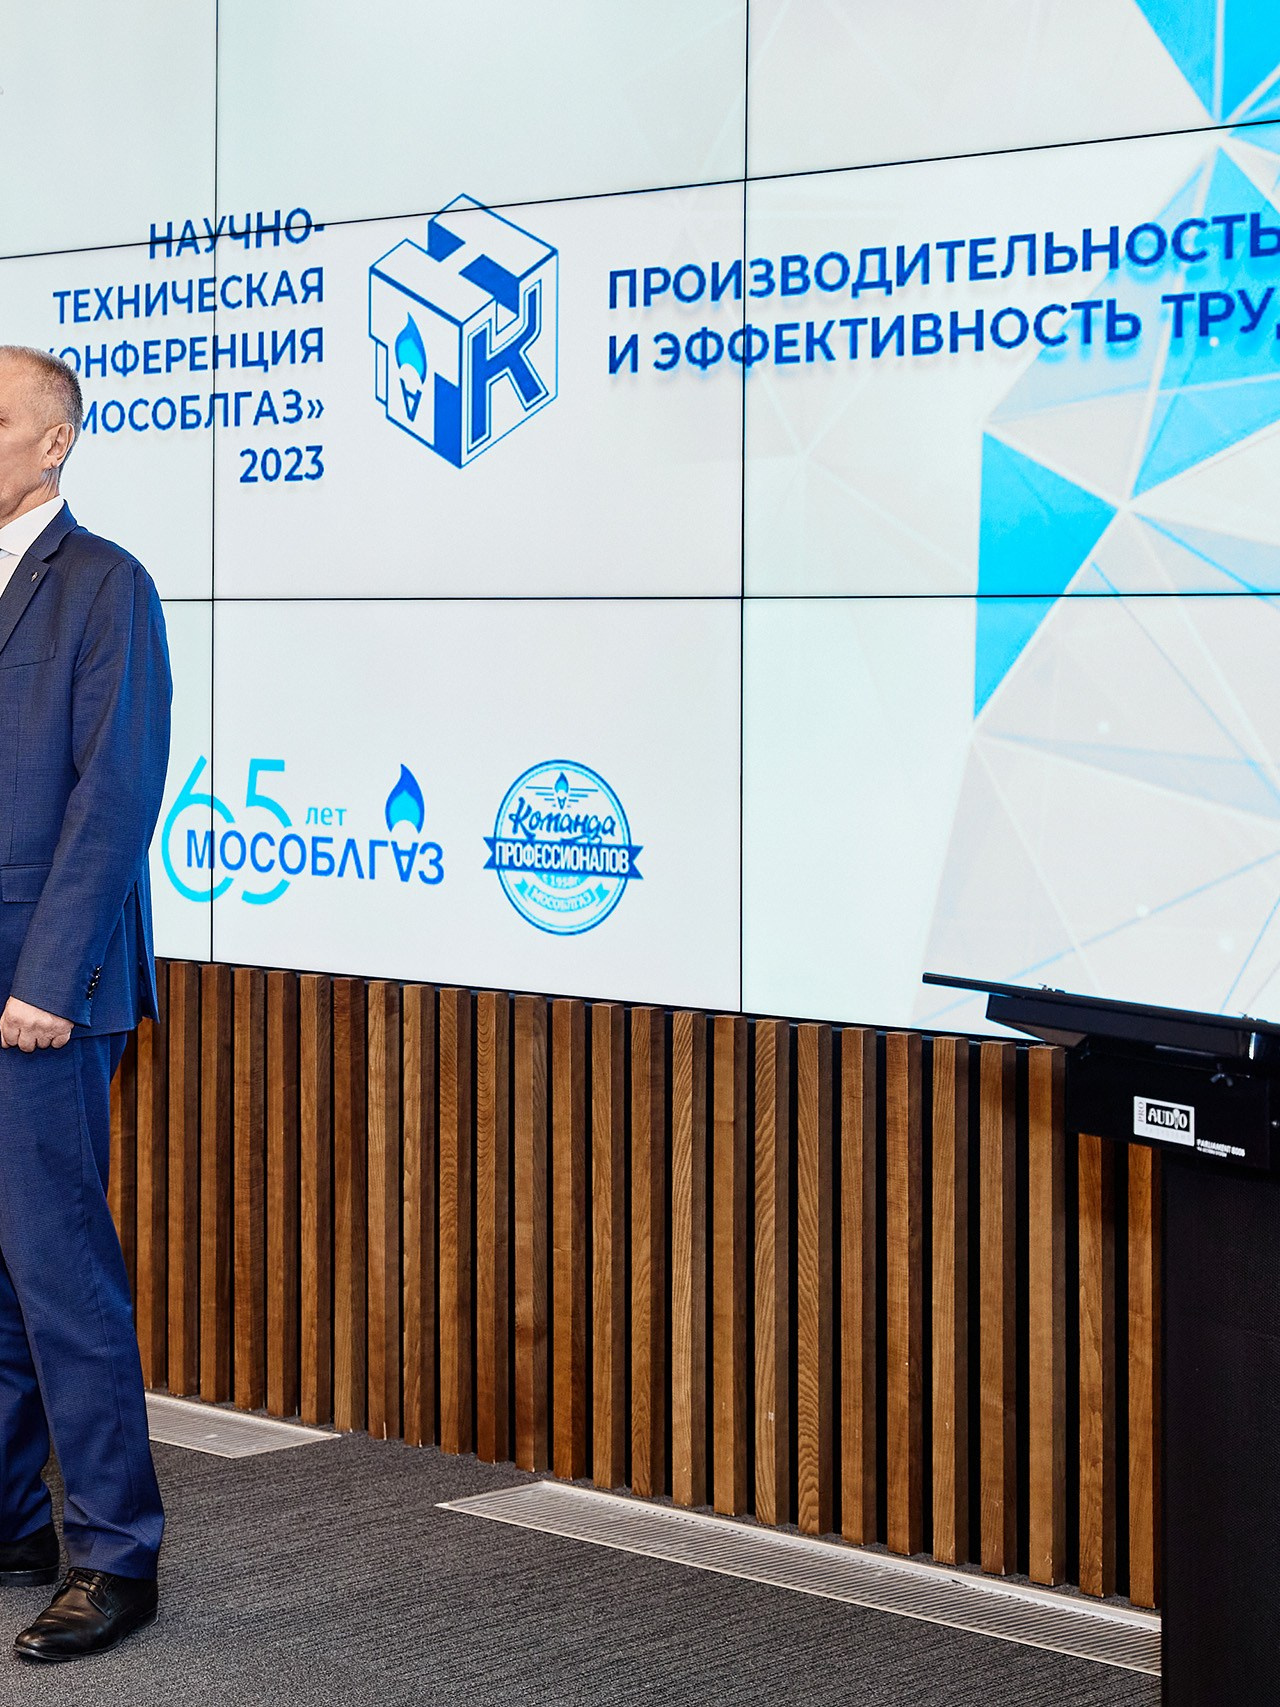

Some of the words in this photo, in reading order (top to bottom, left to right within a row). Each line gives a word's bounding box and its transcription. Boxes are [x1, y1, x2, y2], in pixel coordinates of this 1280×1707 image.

[148, 207, 325, 259] НАУЧНО-
[608, 212, 1280, 310] ПРОИЗВОДИТЕЛЬНОСТЬ
[53, 267, 324, 325] ТЕХНИЧЕСКАЯ
[49, 327, 324, 379] ОНФЕРЕНЦИЯ
[608, 335, 639, 375] И
[653, 298, 1142, 371] ЭФФЕКТИВНОСТЬ
[1161, 287, 1280, 340] ТРУ
[240, 446, 324, 483] 2023
[162, 755, 292, 905] 65
[306, 806, 347, 826] лет
[508, 796, 616, 846] Команда
[186, 829, 444, 885] МОСОБЛГАЗ
[495, 841, 630, 874] ПРОФЕССИОНАЛОВ
